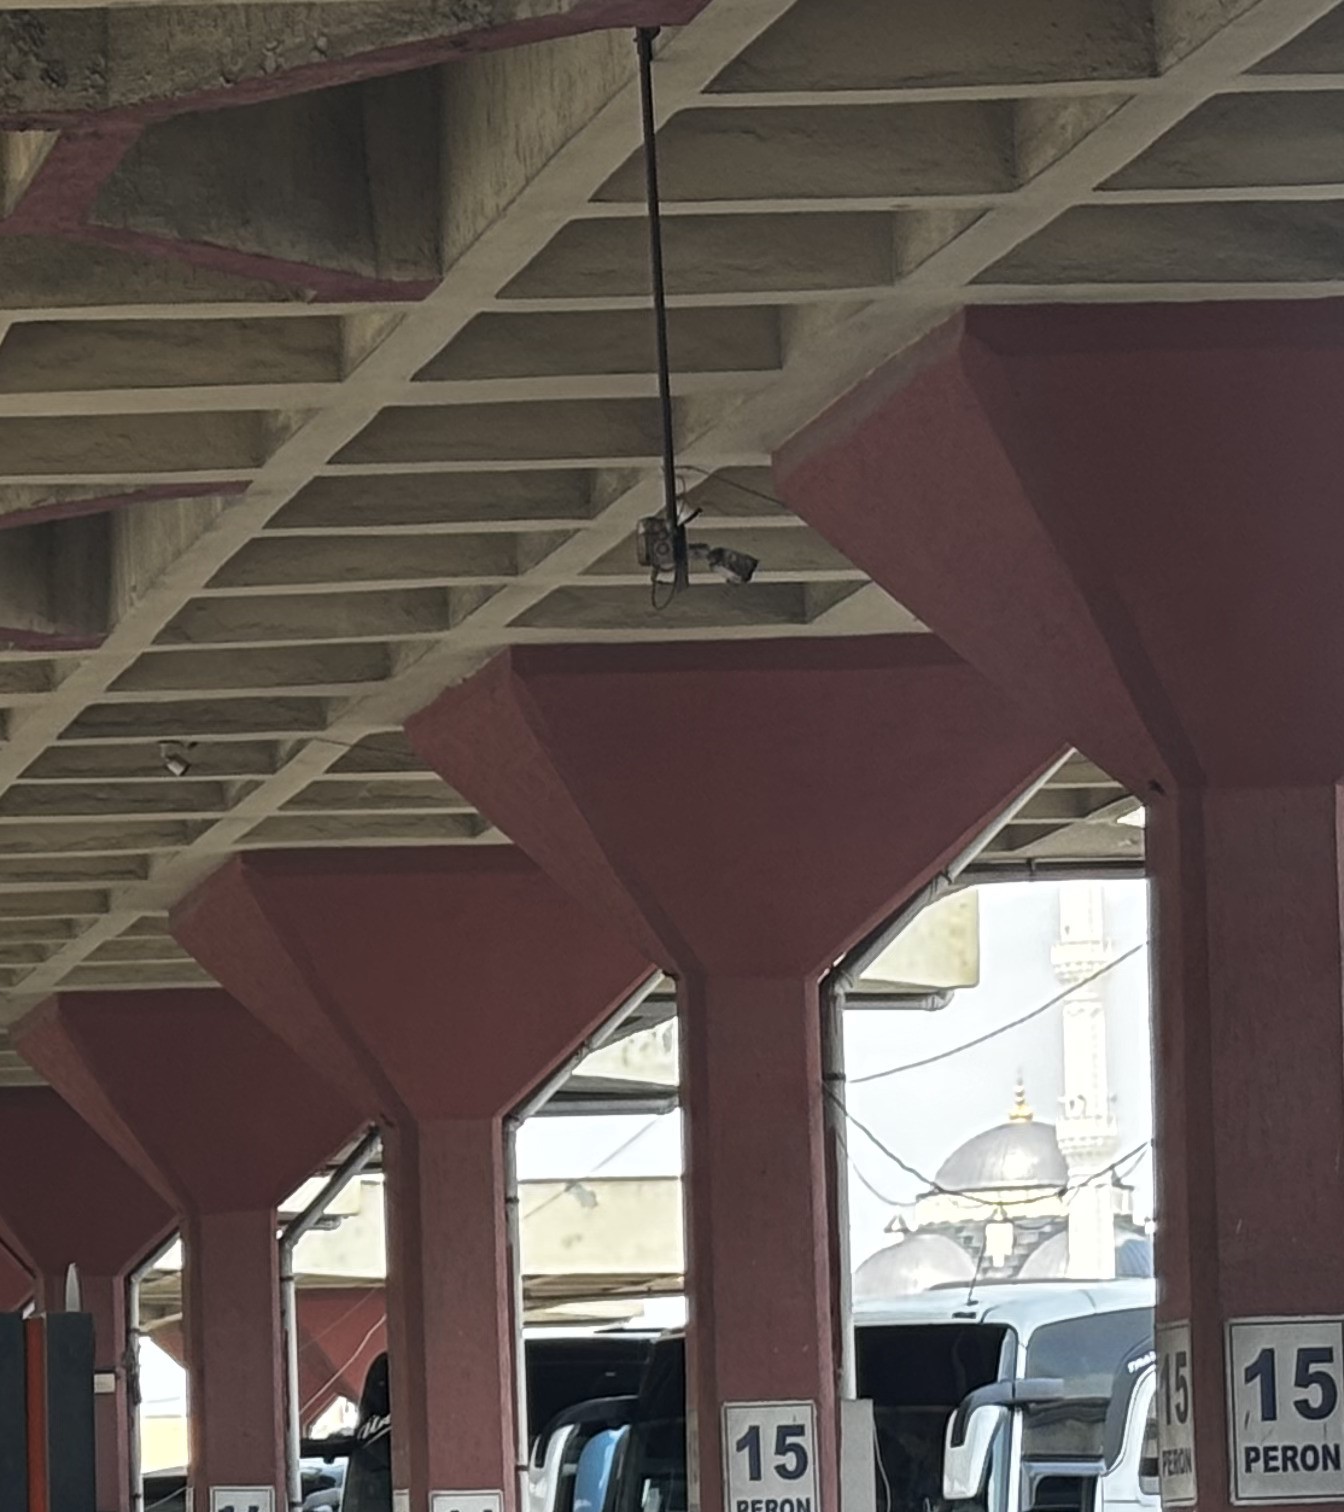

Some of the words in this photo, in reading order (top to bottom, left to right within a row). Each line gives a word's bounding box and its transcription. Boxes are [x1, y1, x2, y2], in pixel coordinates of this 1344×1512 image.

[1243, 1347, 1338, 1423] 15
[735, 1423, 809, 1482] 15
[1243, 1443, 1342, 1474] PERON
